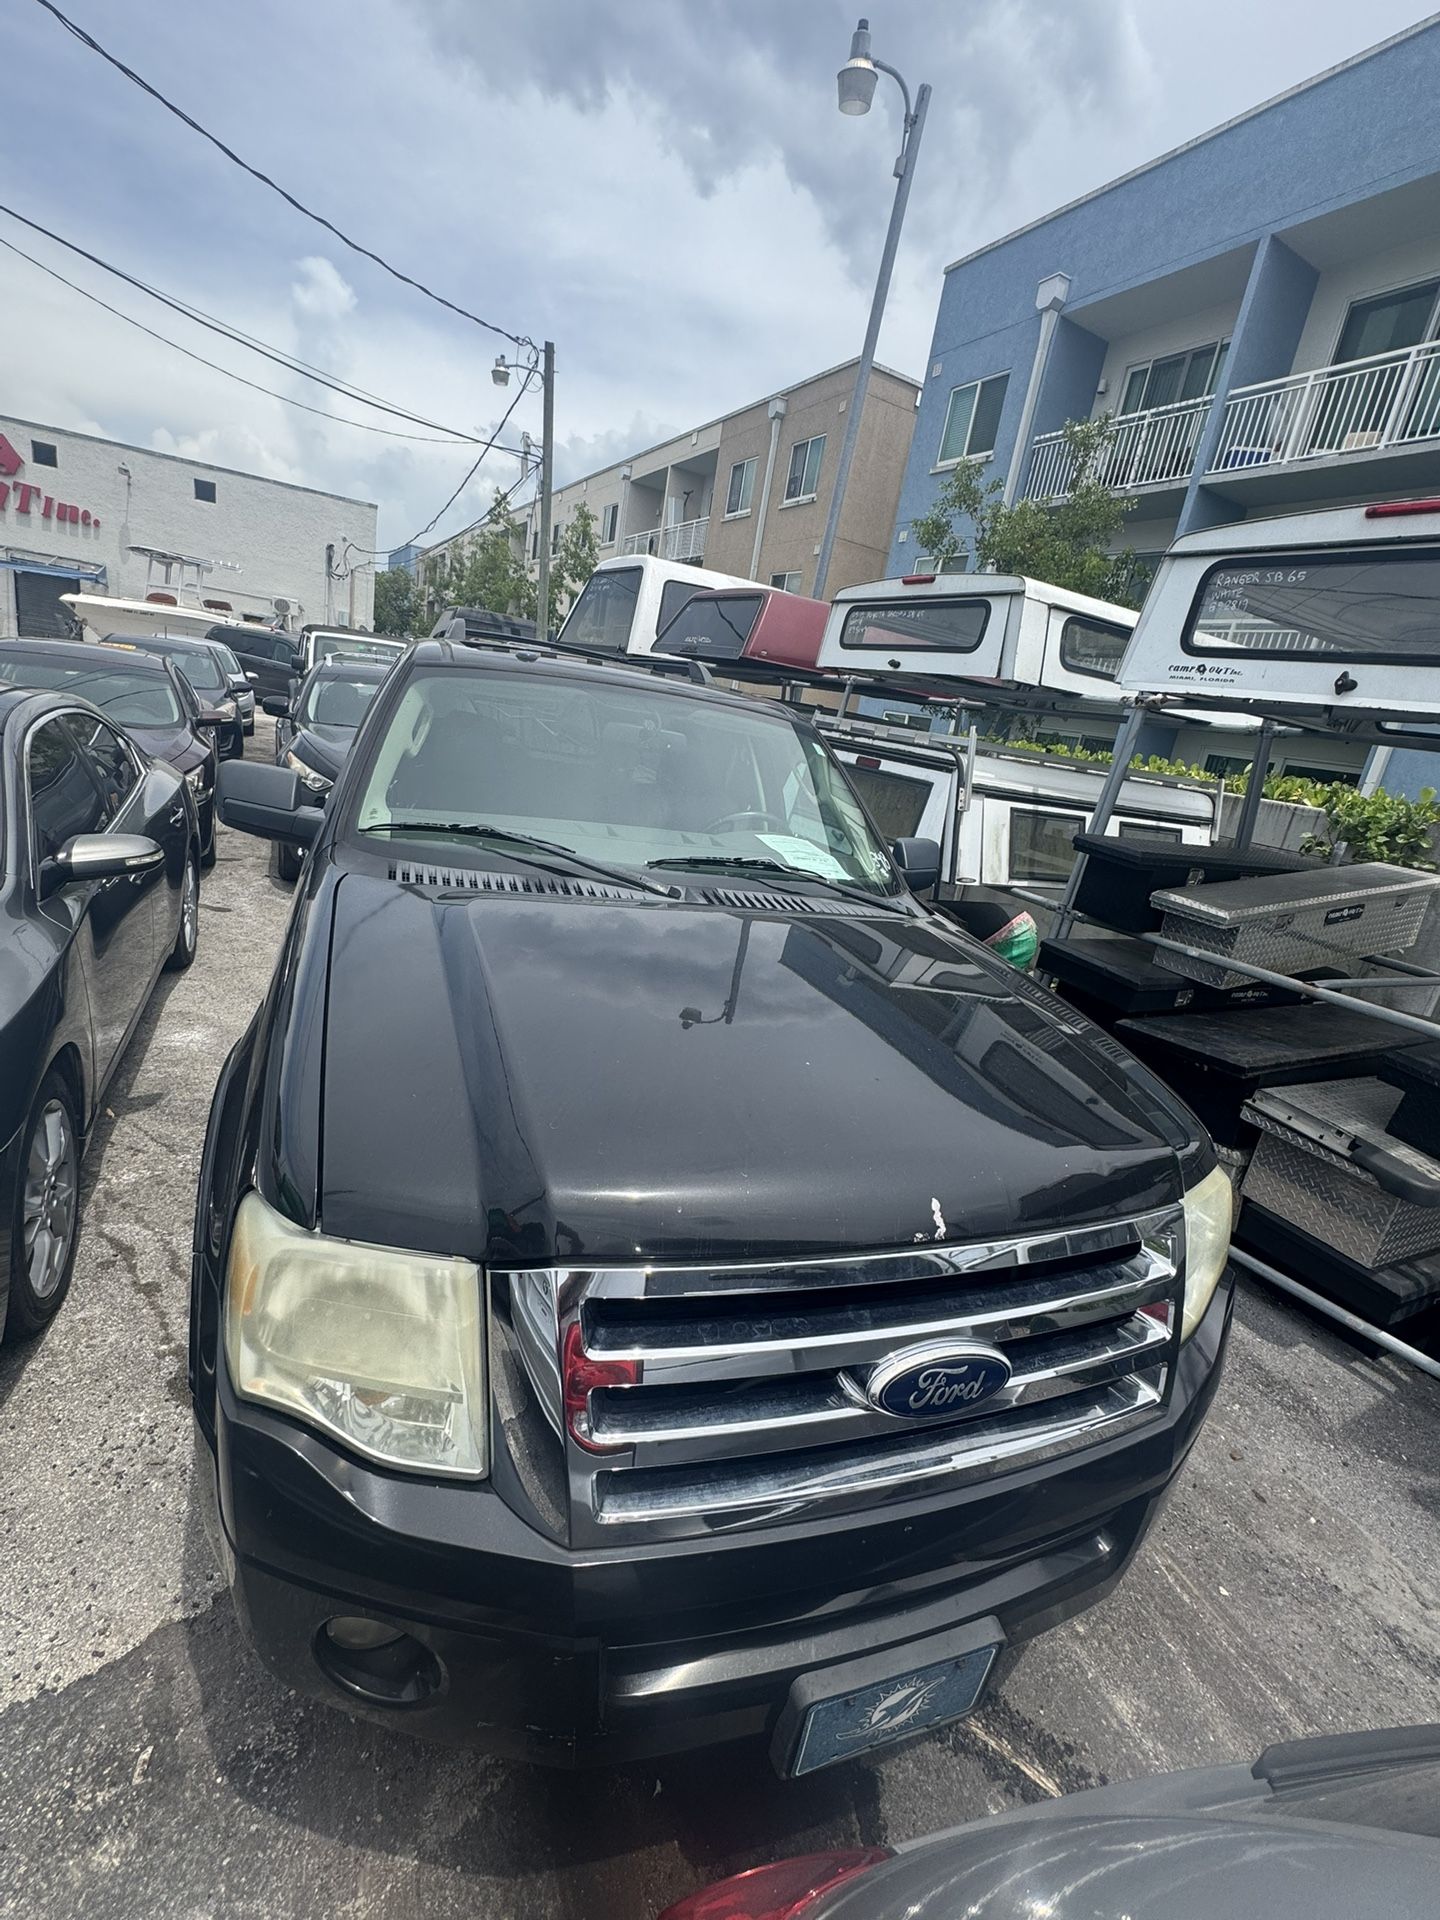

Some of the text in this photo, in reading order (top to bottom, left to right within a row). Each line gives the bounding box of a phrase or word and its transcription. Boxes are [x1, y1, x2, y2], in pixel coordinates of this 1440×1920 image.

[1216, 570, 1308, 588] RANGER SB 65
[1211, 587, 1244, 601] WHITE
[909, 1365, 986, 1409] Ford
